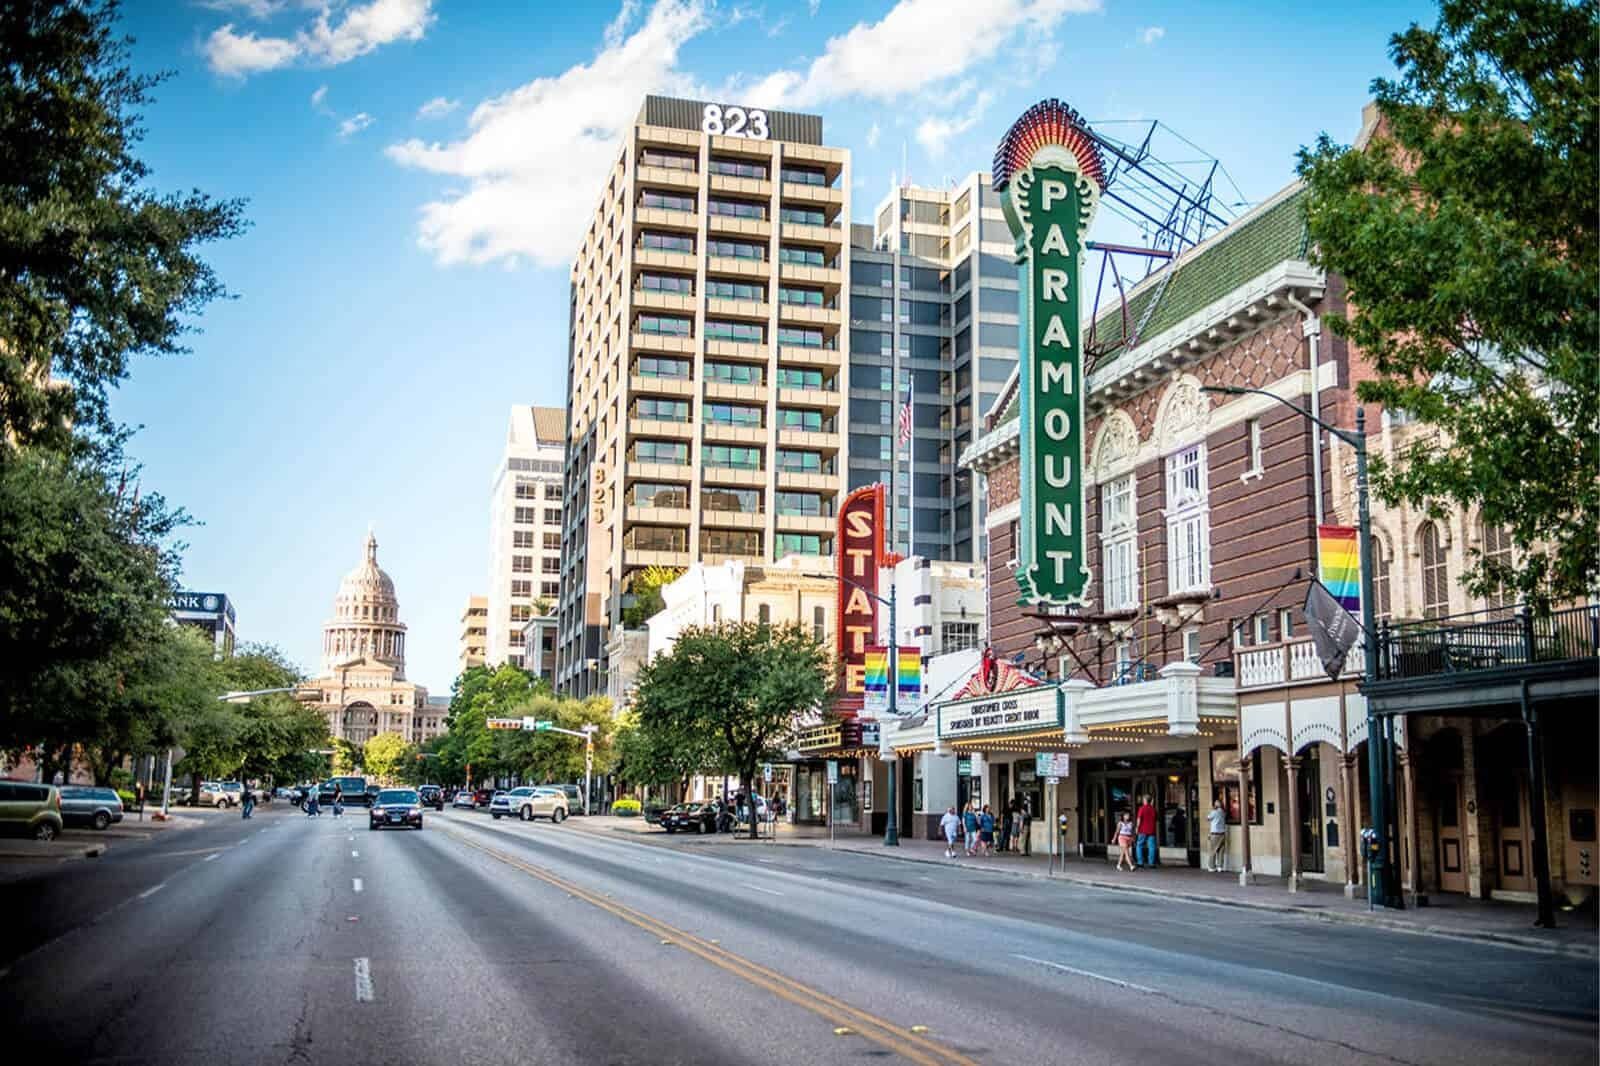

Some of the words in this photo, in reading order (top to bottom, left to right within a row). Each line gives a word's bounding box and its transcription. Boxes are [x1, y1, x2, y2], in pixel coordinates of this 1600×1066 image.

[703, 104, 769, 140] 823
[1041, 180, 1073, 585] PARAMOUNT
[593, 469, 606, 524] 823
[846, 511, 873, 693] STATE
